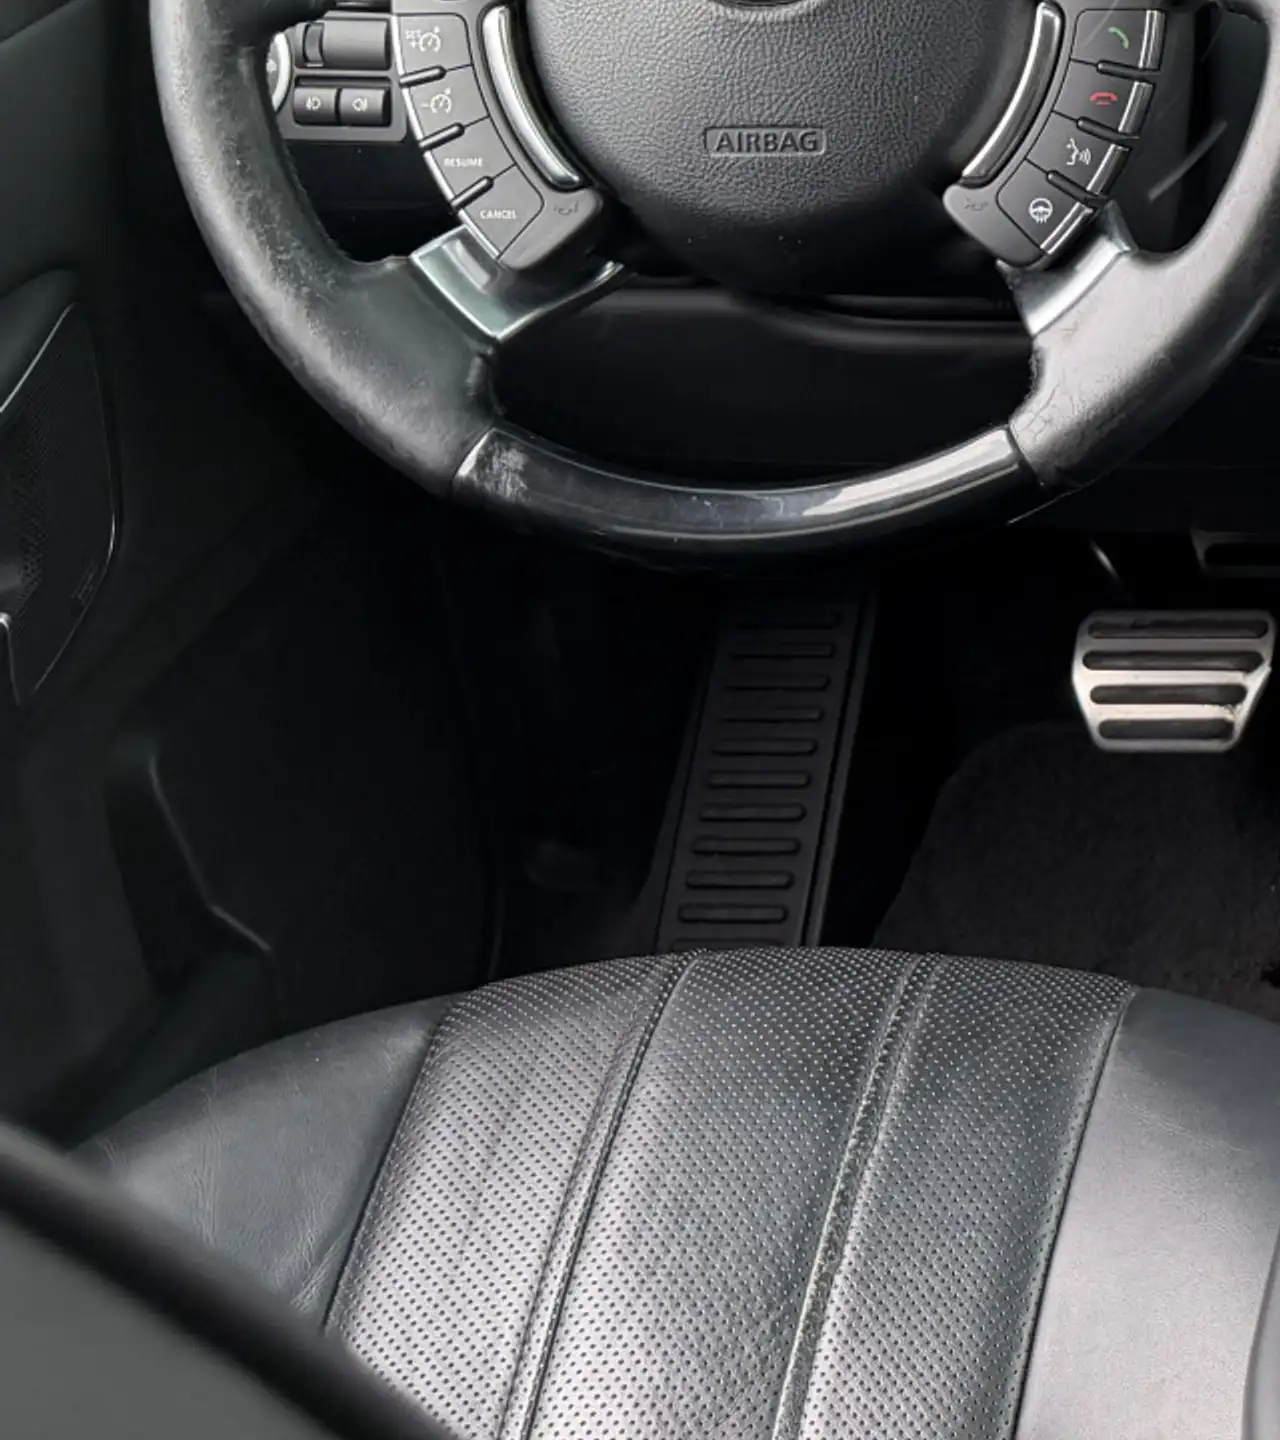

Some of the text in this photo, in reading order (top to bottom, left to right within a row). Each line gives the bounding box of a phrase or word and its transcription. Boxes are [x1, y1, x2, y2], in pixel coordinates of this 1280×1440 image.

[715, 131, 818, 152] AIRBAG
[443, 158, 483, 167] RESUME
[480, 210, 517, 219] CANCEL
